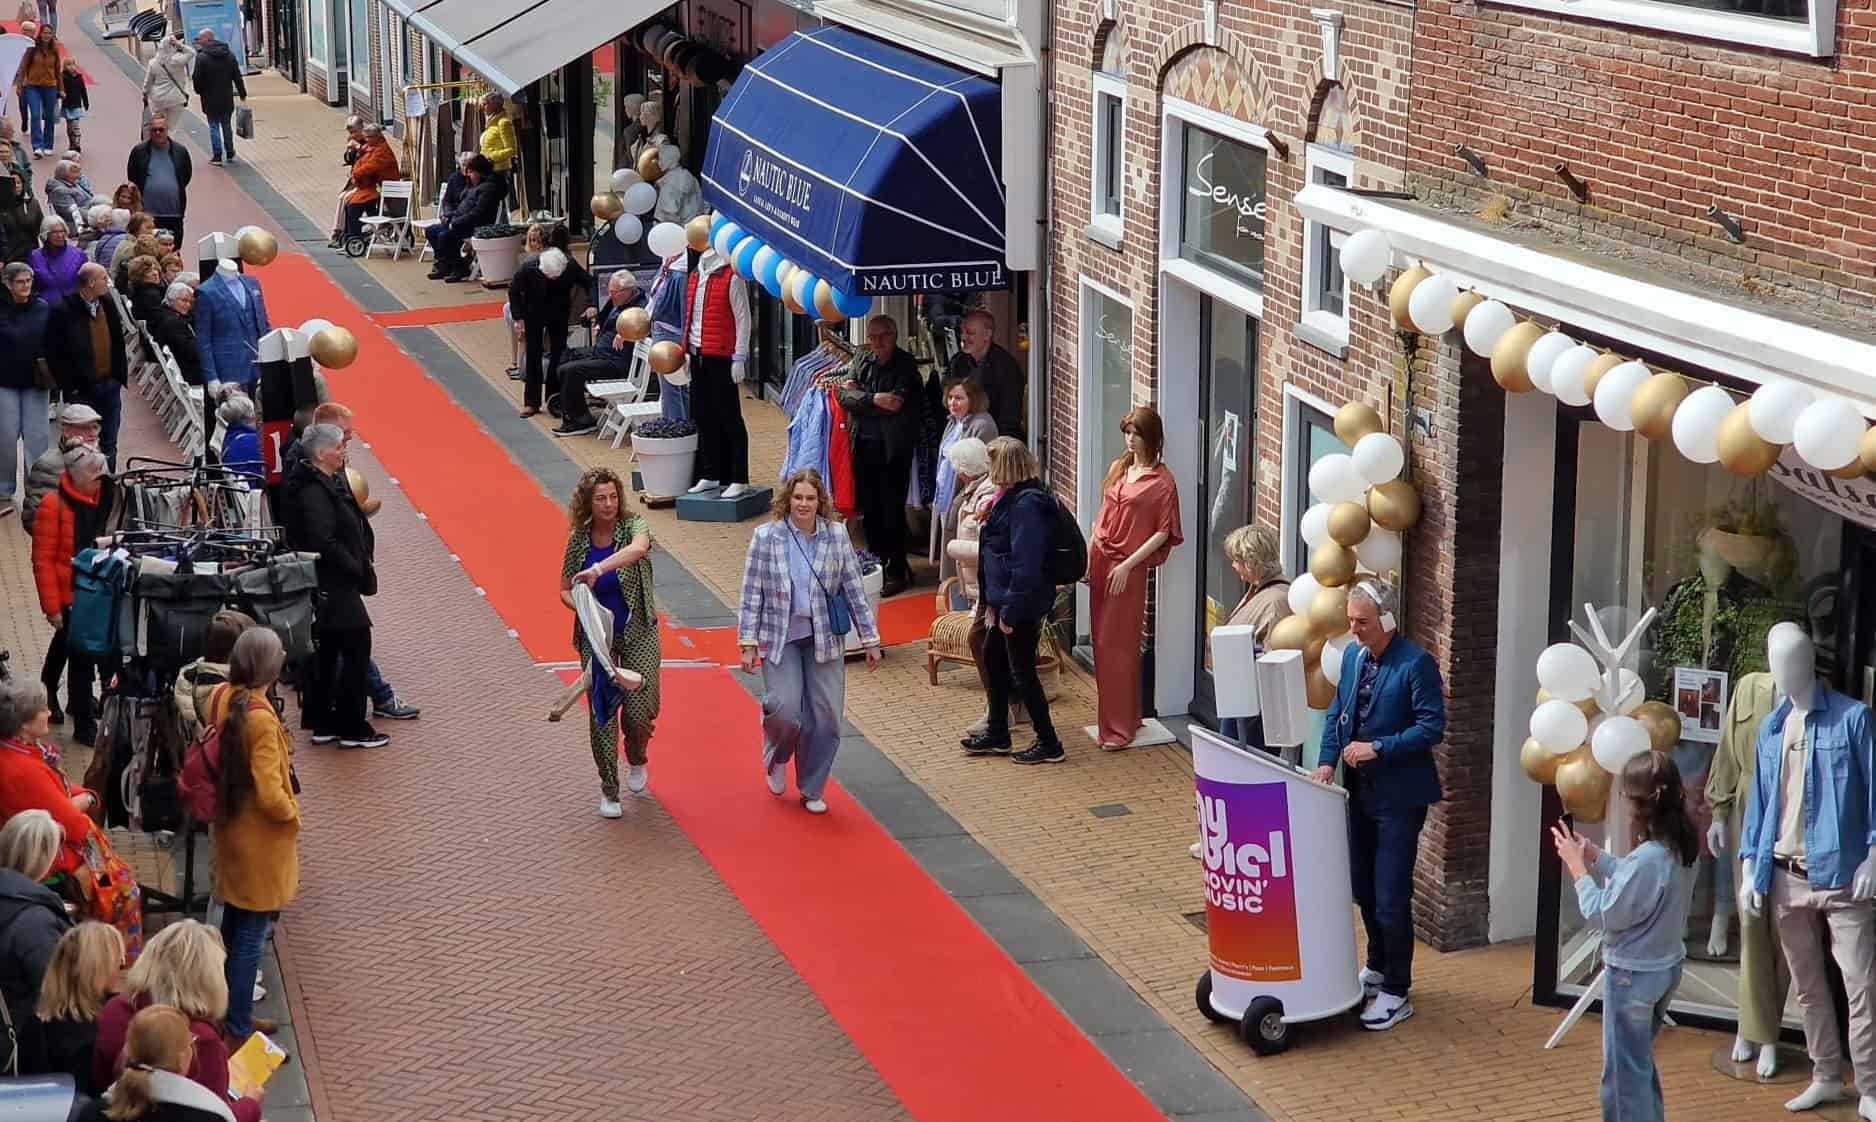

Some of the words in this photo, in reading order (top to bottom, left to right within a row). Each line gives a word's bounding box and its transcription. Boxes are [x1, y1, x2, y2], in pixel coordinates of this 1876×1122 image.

[752, 155, 788, 197] NAUTIC
[1189, 152, 1266, 220] Sense
[863, 273, 944, 291] NAUTIC
